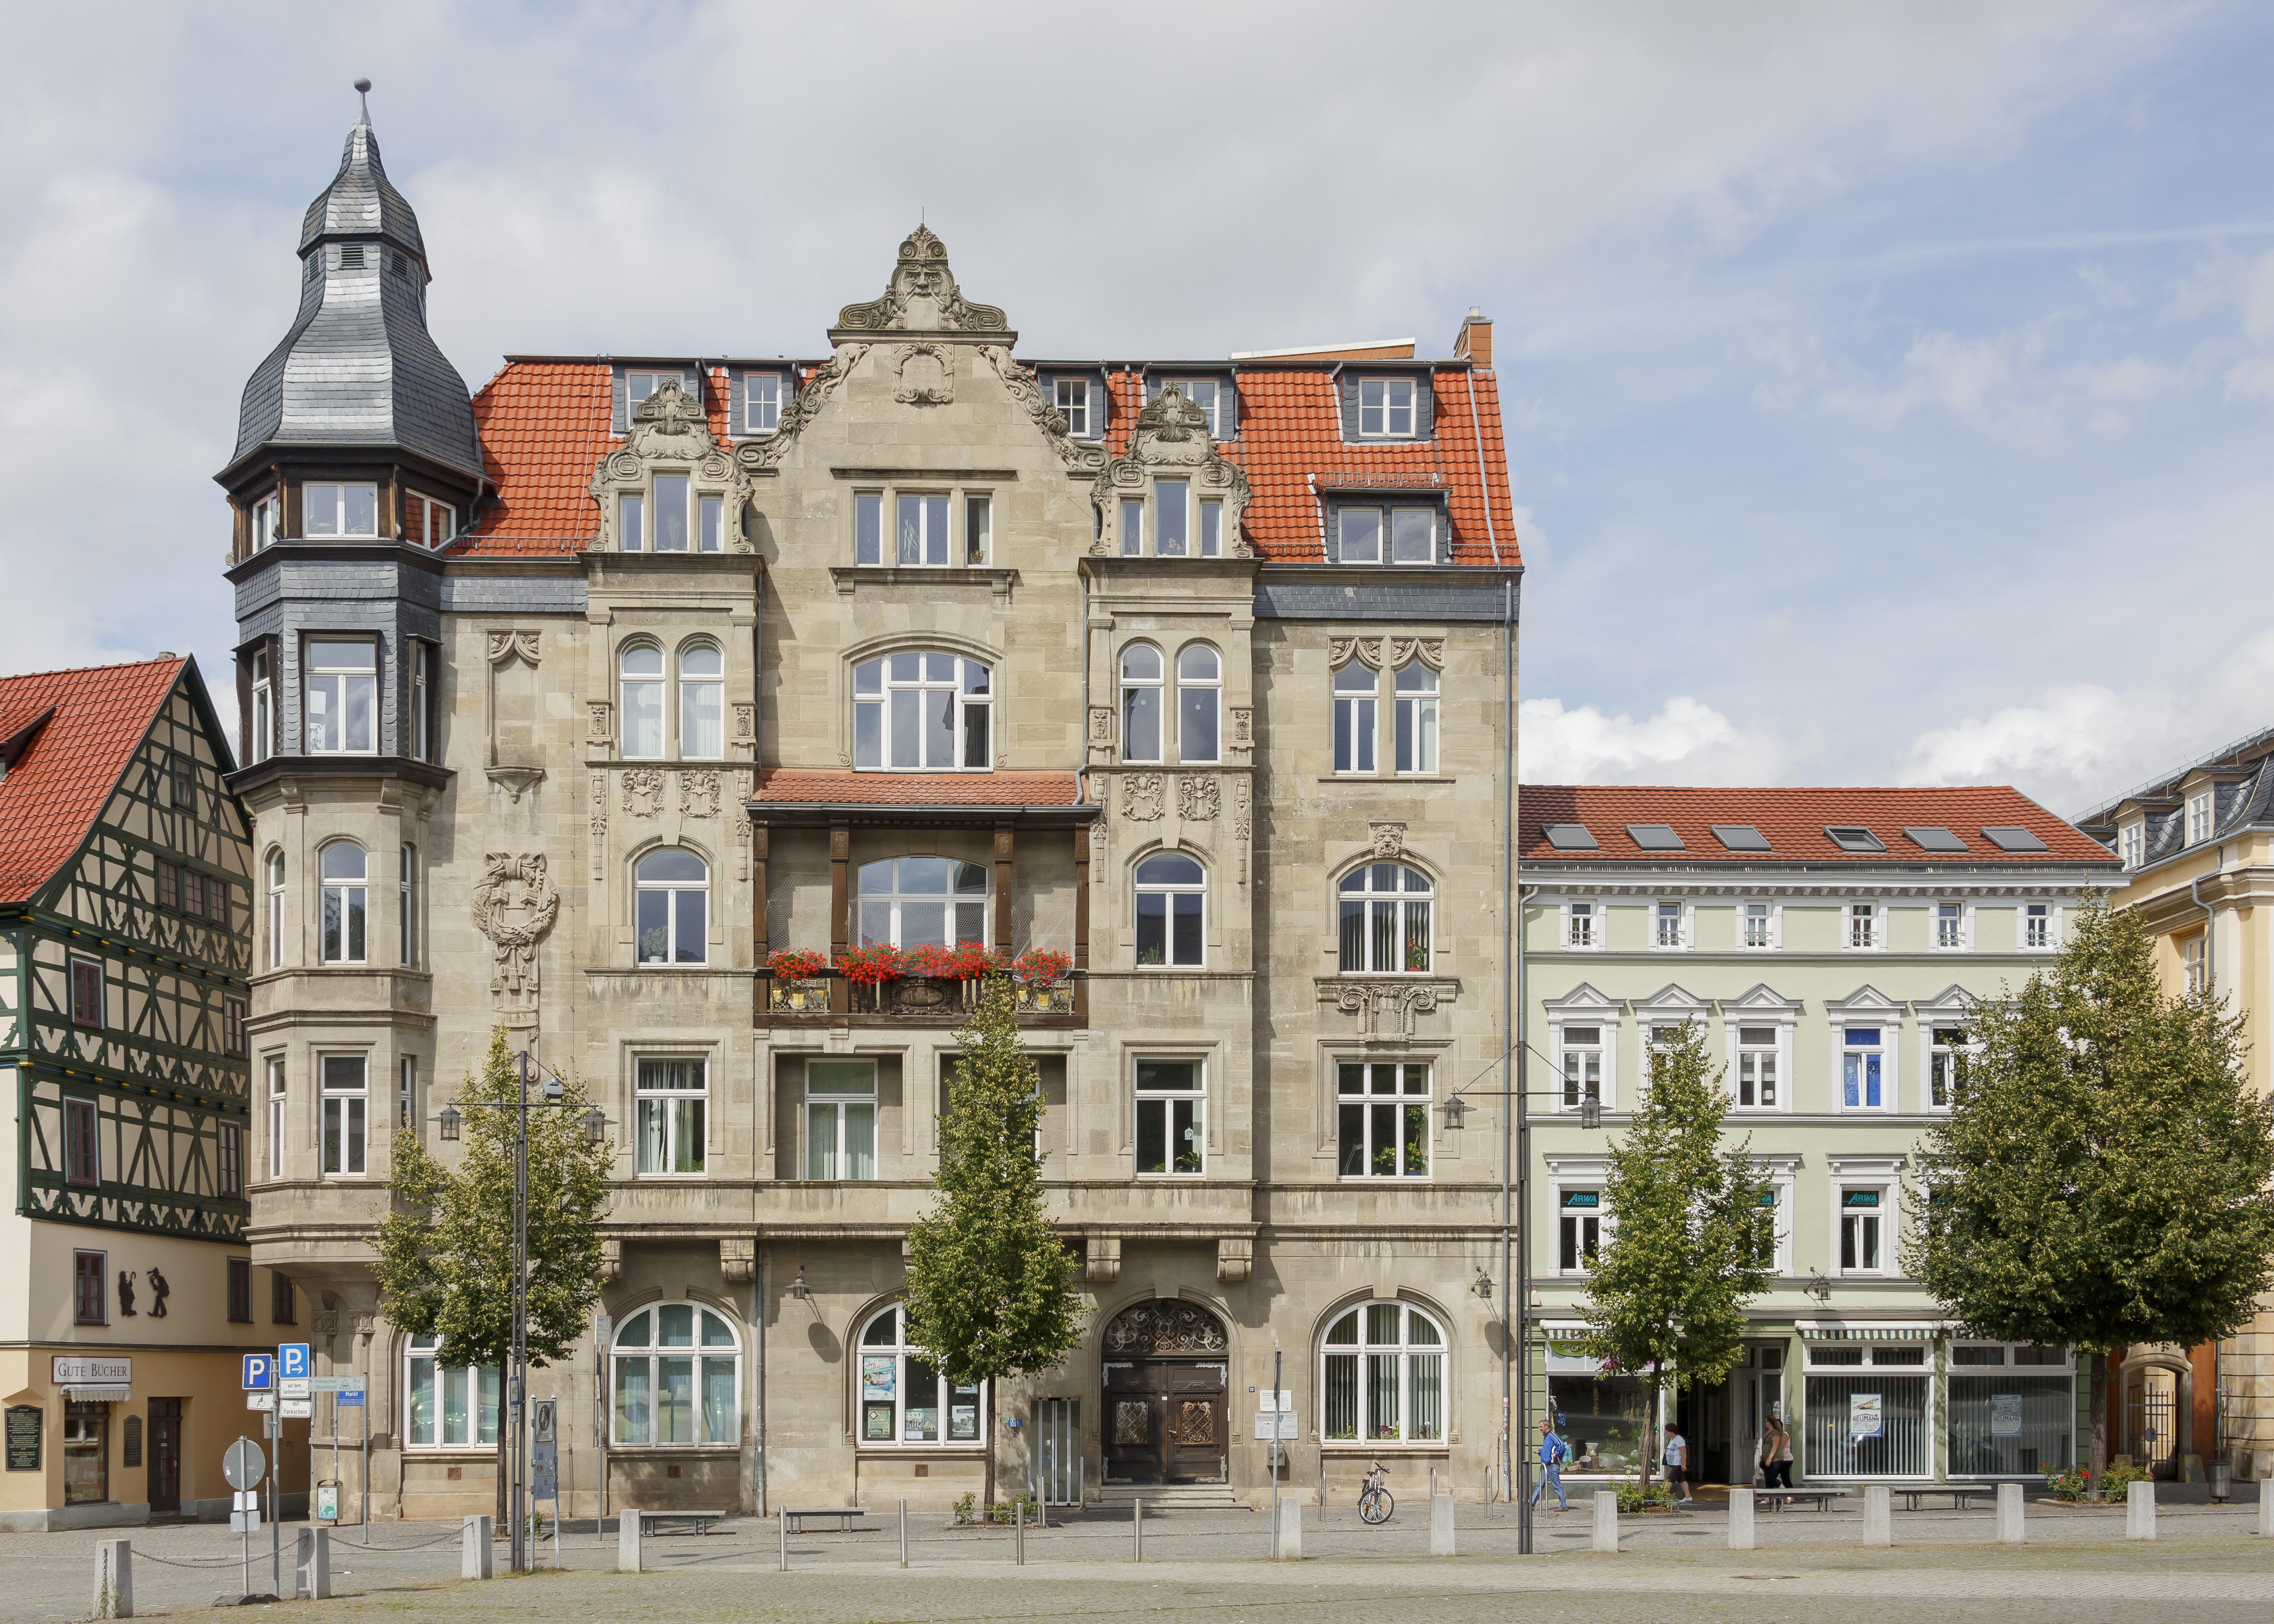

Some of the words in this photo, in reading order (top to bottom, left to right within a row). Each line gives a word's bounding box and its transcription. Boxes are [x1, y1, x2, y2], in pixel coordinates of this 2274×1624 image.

[1567, 1193, 1596, 1205] ARWA
[1848, 1193, 1877, 1204] ARWA
[286, 1349, 302, 1374] P
[58, 1363, 86, 1377] GUTE
[91, 1363, 128, 1377] BÜCHER
[249, 1359, 265, 1385] P
